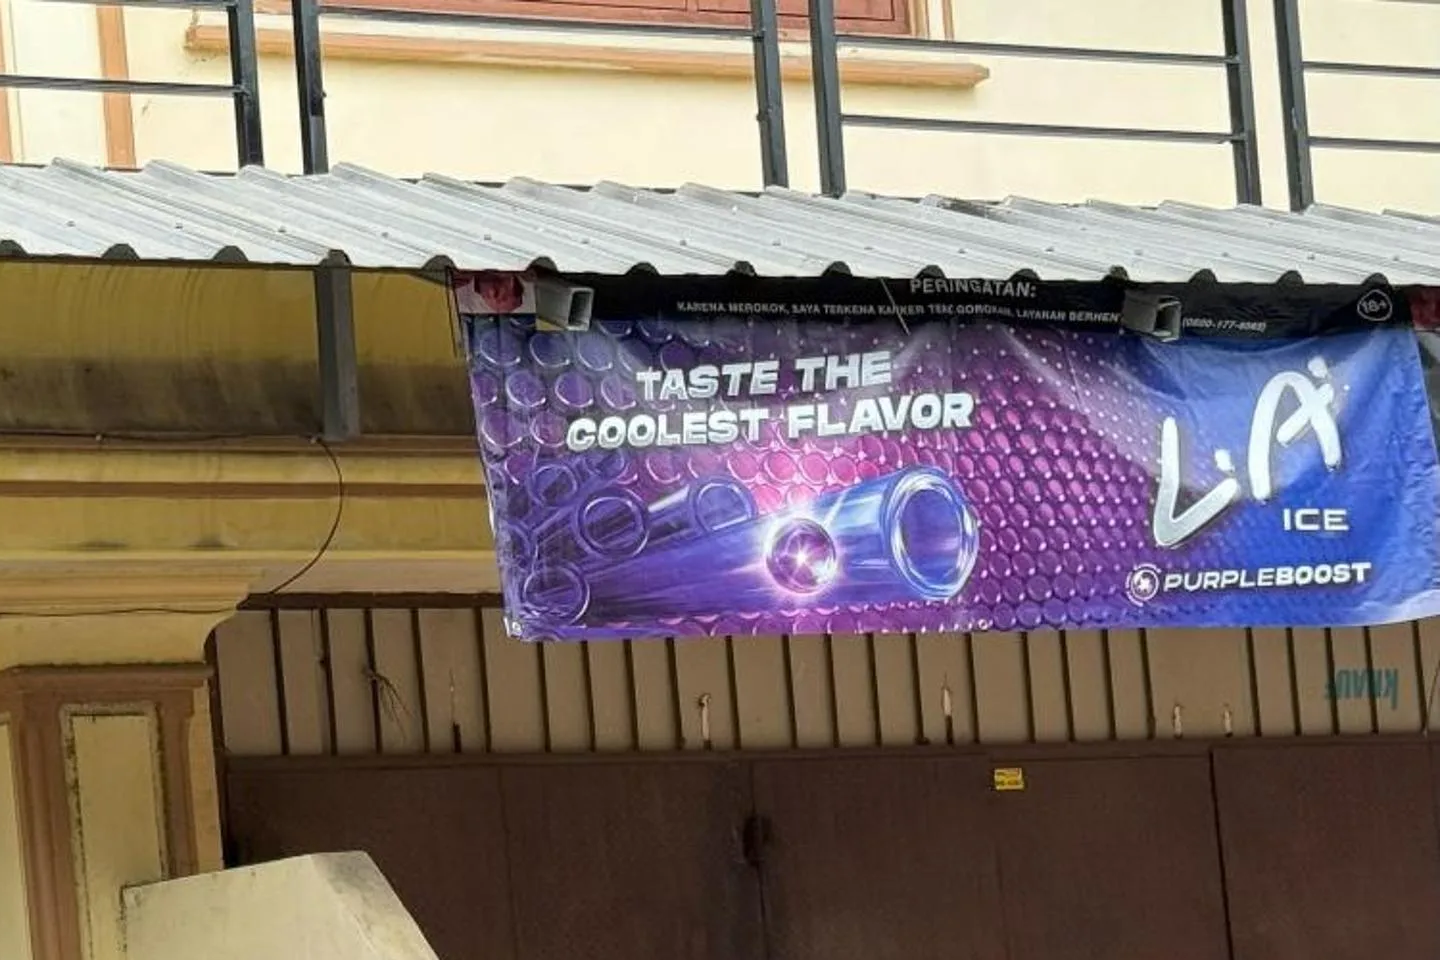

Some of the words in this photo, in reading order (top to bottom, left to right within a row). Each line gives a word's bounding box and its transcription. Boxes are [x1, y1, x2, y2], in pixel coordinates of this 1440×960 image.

[910, 278, 1037, 298] PERINGATAN:
[677, 301, 725, 314] KARENA
[792, 303, 821, 315] SAYA
[824, 304, 877, 316] TERKENA
[636, 360, 779, 403] TASTE
[795, 351, 893, 390] THE
[565, 408, 768, 453] COOLEST
[787, 392, 976, 439] FLAVOR
[1282, 507, 1350, 532] ICE
[1163, 561, 1372, 592] PURPLEBOOST
